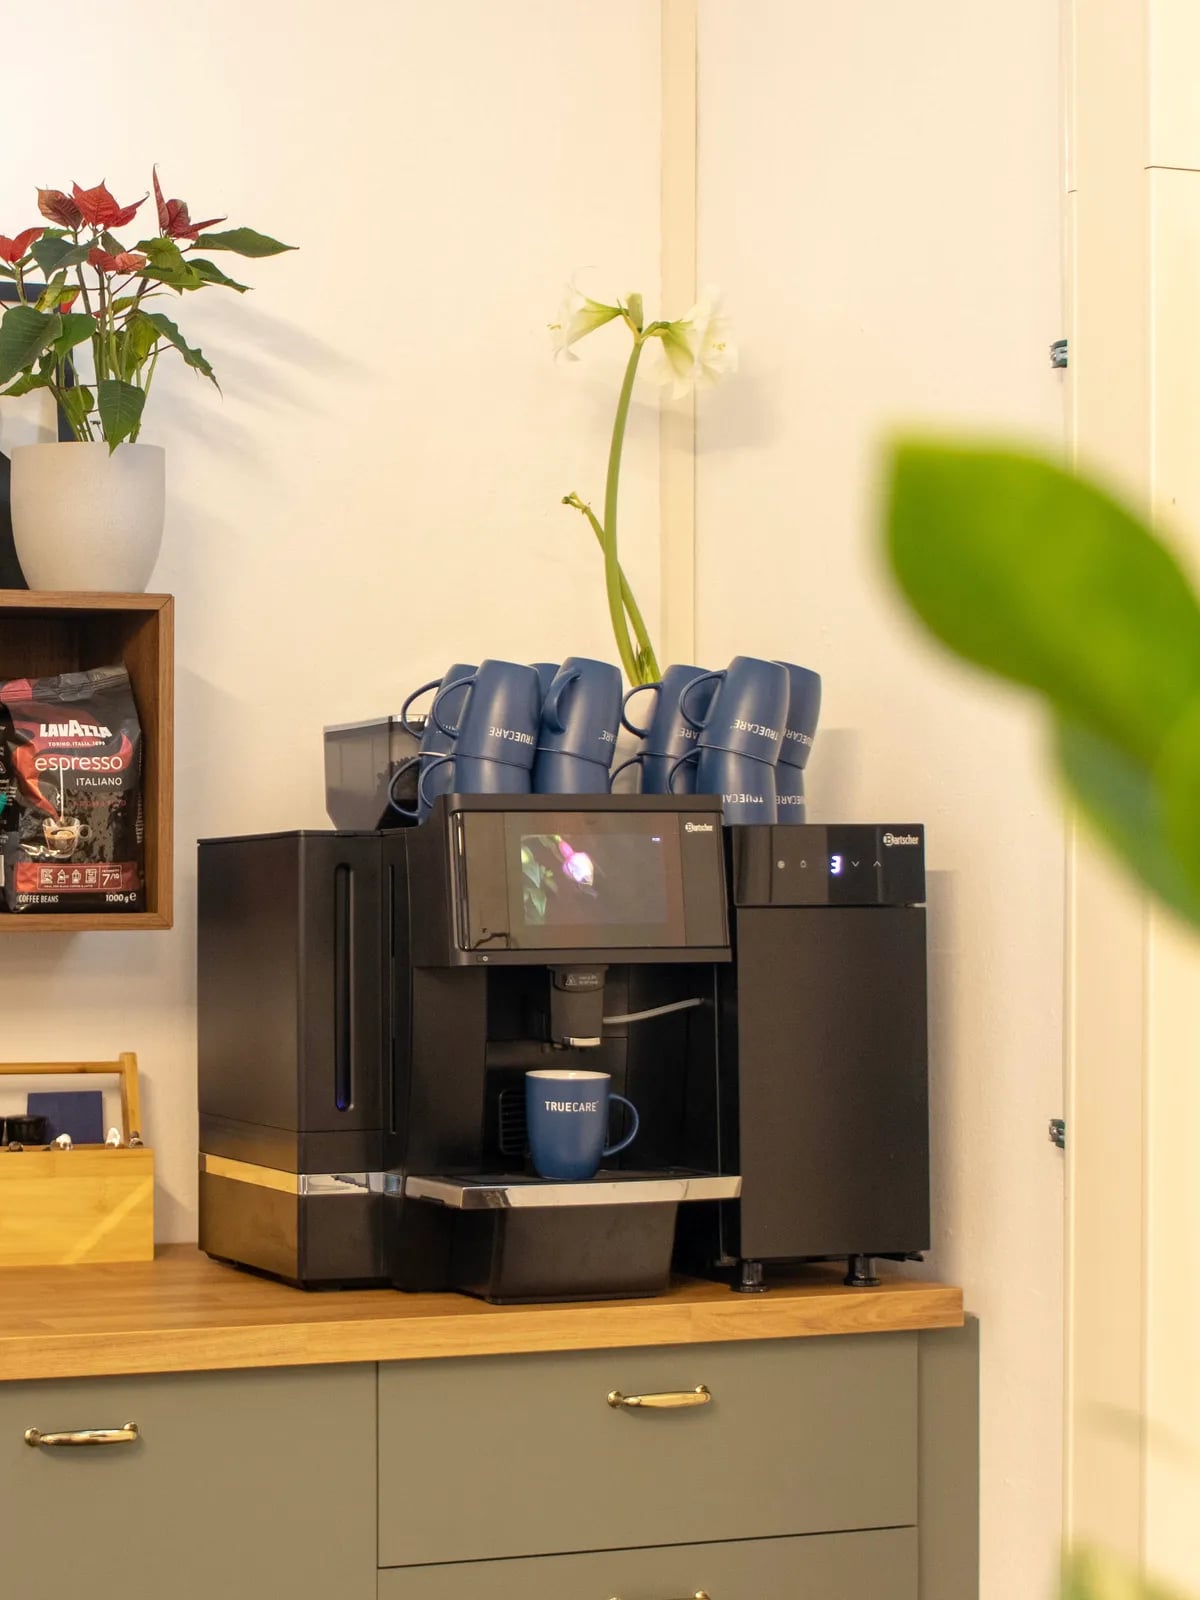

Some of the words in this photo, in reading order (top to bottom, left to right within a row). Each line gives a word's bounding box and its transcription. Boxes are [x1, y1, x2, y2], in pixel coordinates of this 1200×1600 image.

[40, 720, 113, 738] LAVAZZA
[489, 726, 534, 745] TRUECARE
[733, 719, 779, 741] TRUECARE
[34, 756, 123, 771] espresso
[76, 777, 122, 786] ITALIANO
[883, 833, 919, 846] Bartscher
[830, 855, 842, 874] 3
[19, 895, 40, 903] COFFEE
[41, 895, 59, 903] BEANS
[545, 1101, 597, 1112] TRUECARE
